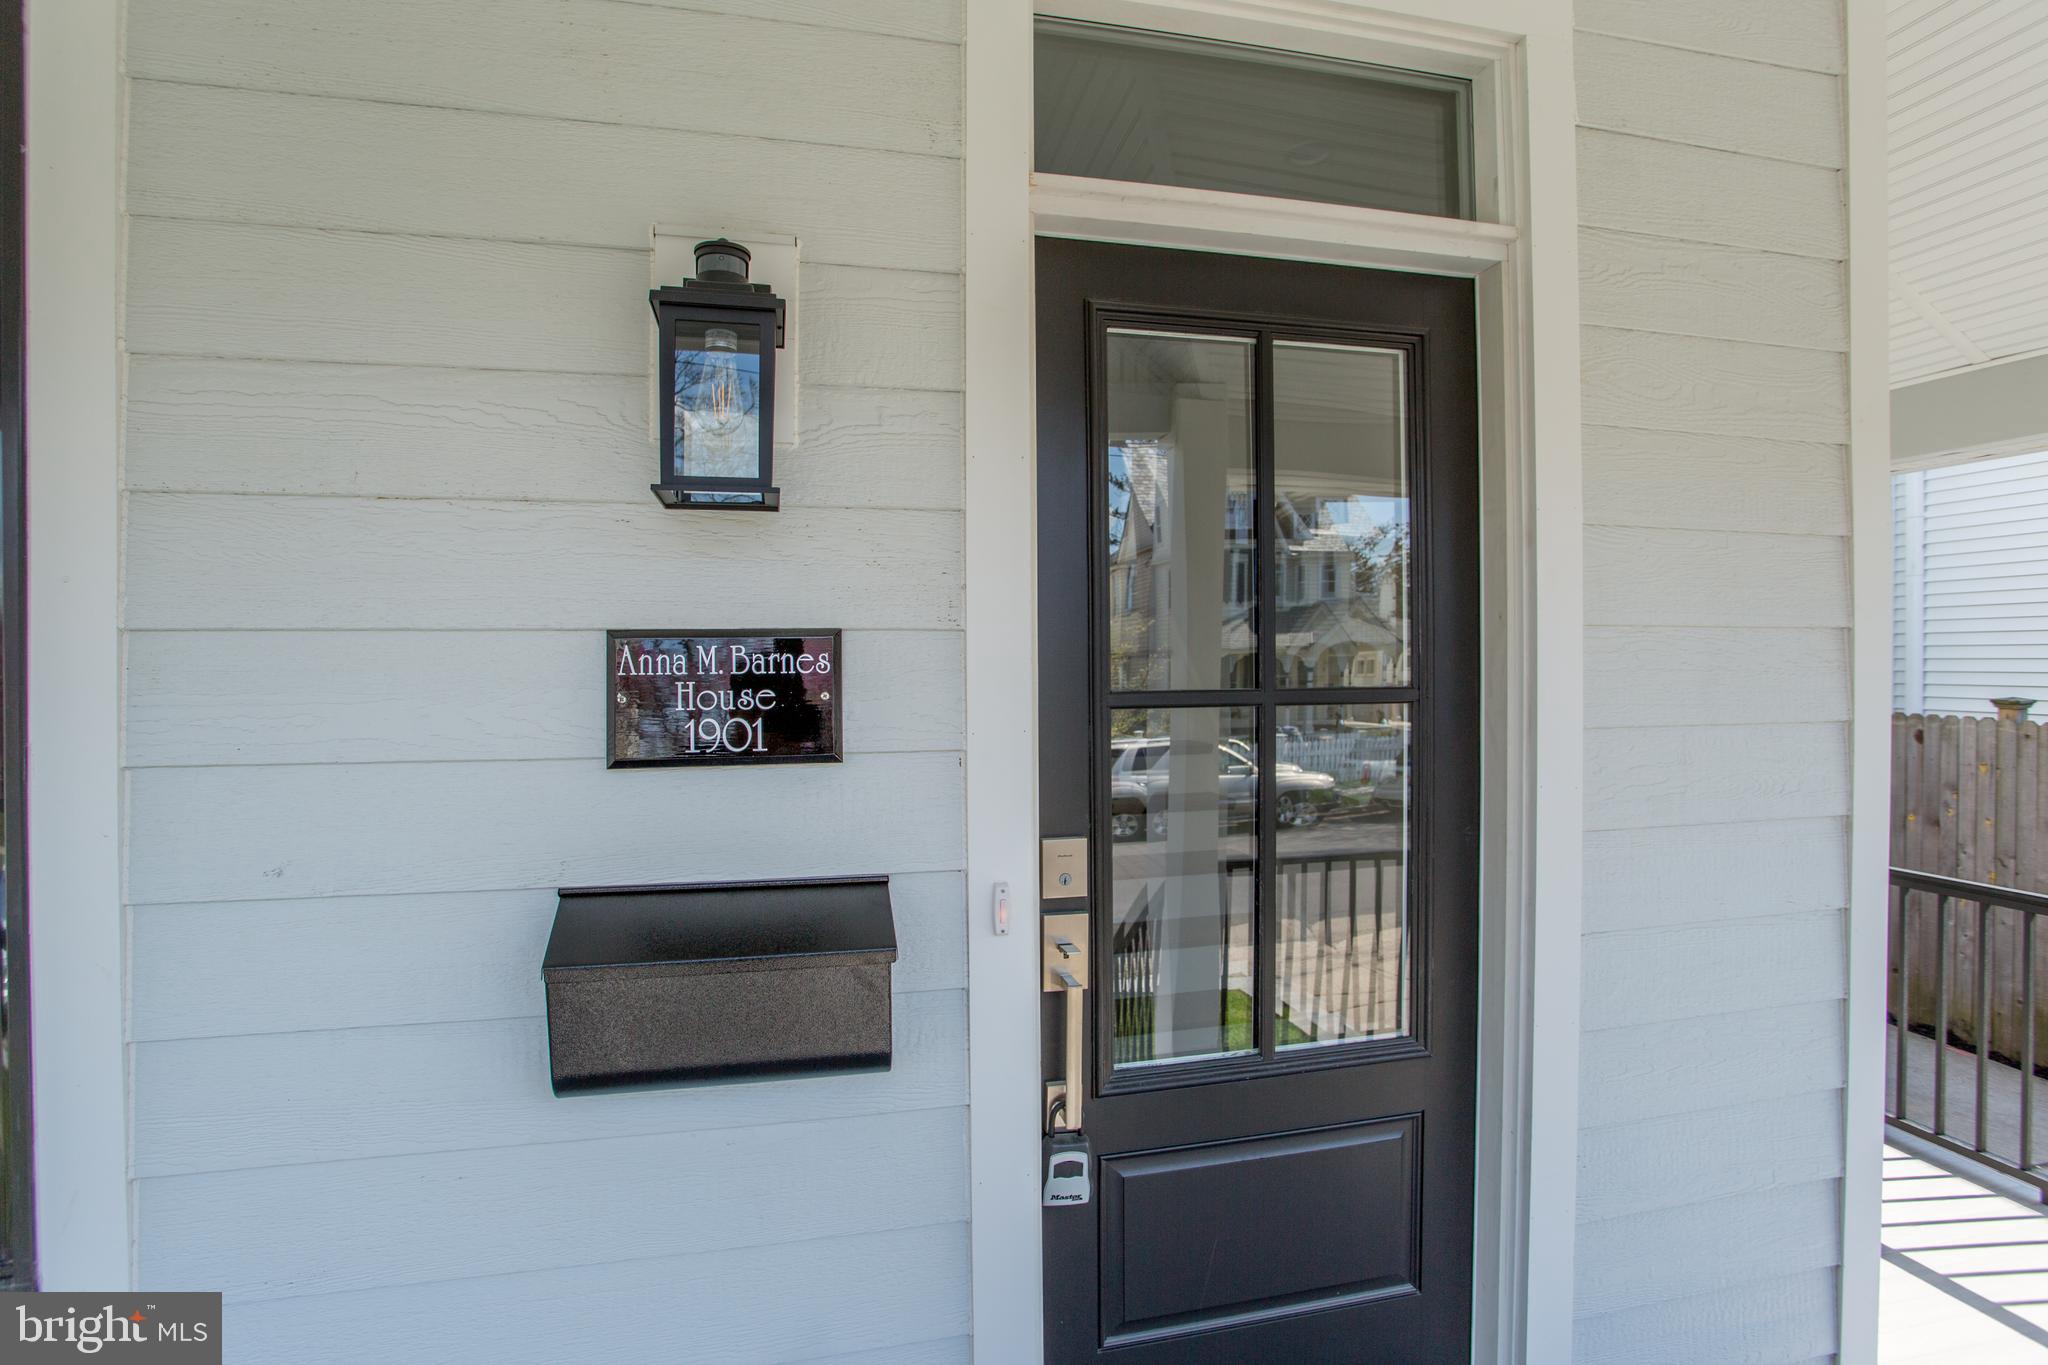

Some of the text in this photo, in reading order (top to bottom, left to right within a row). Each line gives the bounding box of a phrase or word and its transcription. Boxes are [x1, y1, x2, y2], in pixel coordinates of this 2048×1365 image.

[617, 644, 831, 676] Anna M. Barnes
[674, 681, 776, 711] House
[684, 717, 768, 753] 1901
